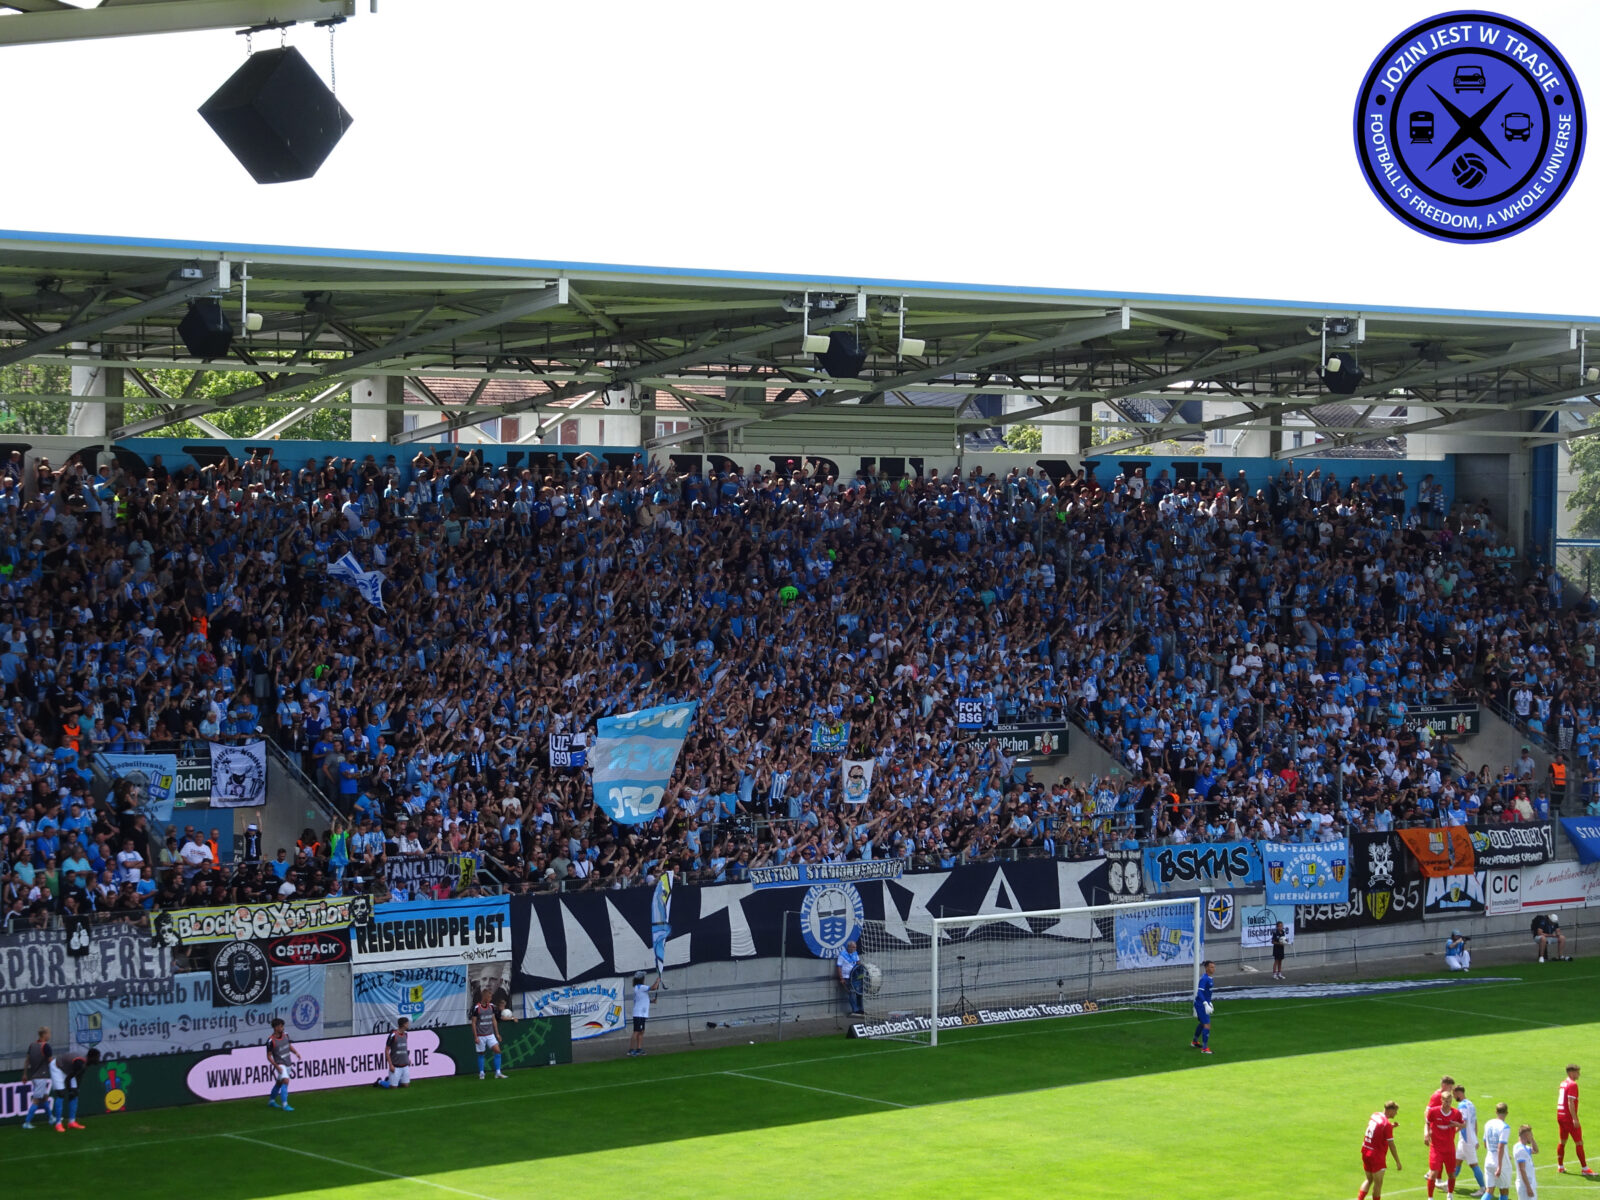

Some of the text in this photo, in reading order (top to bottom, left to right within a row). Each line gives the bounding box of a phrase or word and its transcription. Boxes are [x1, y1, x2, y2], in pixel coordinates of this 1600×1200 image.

[959, 702, 983, 712] FCK
[959, 712, 983, 723] BSG
[554, 752, 567, 765] 99
[176, 774, 211, 795] ßchen
[1488, 829, 1514, 849] OLD
[1510, 827, 1543, 847] BLOCK
[384, 859, 446, 880] FANCLUB
[1157, 846, 1251, 883] BSKMS
[750, 867, 799, 884] SEKTION
[1492, 874, 1519, 894] CIC
[1392, 880, 1420, 911] 85
[801, 884, 823, 934] ULTRAS
[1247, 916, 1266, 926] fokus
[18, 924, 139, 943] FUSSBLCLUB
[356, 913, 506, 954] REISEGRUPPE OST
[1247, 926, 1290, 939] fischerwse
[100, 937, 169, 983] FREI
[275, 943, 336, 957] OSTPACK
[57, 986, 98, 1000] MARX
[125, 981, 170, 993] STADT
[533, 984, 618, 1011] CFC-Fanclub
[401, 1003, 421, 1013] CFC
[853, 1020, 917, 1038] Eisenbach
[978, 1004, 1040, 1023] Eisenbach
[1039, 999, 1099, 1015] Tresore.de
